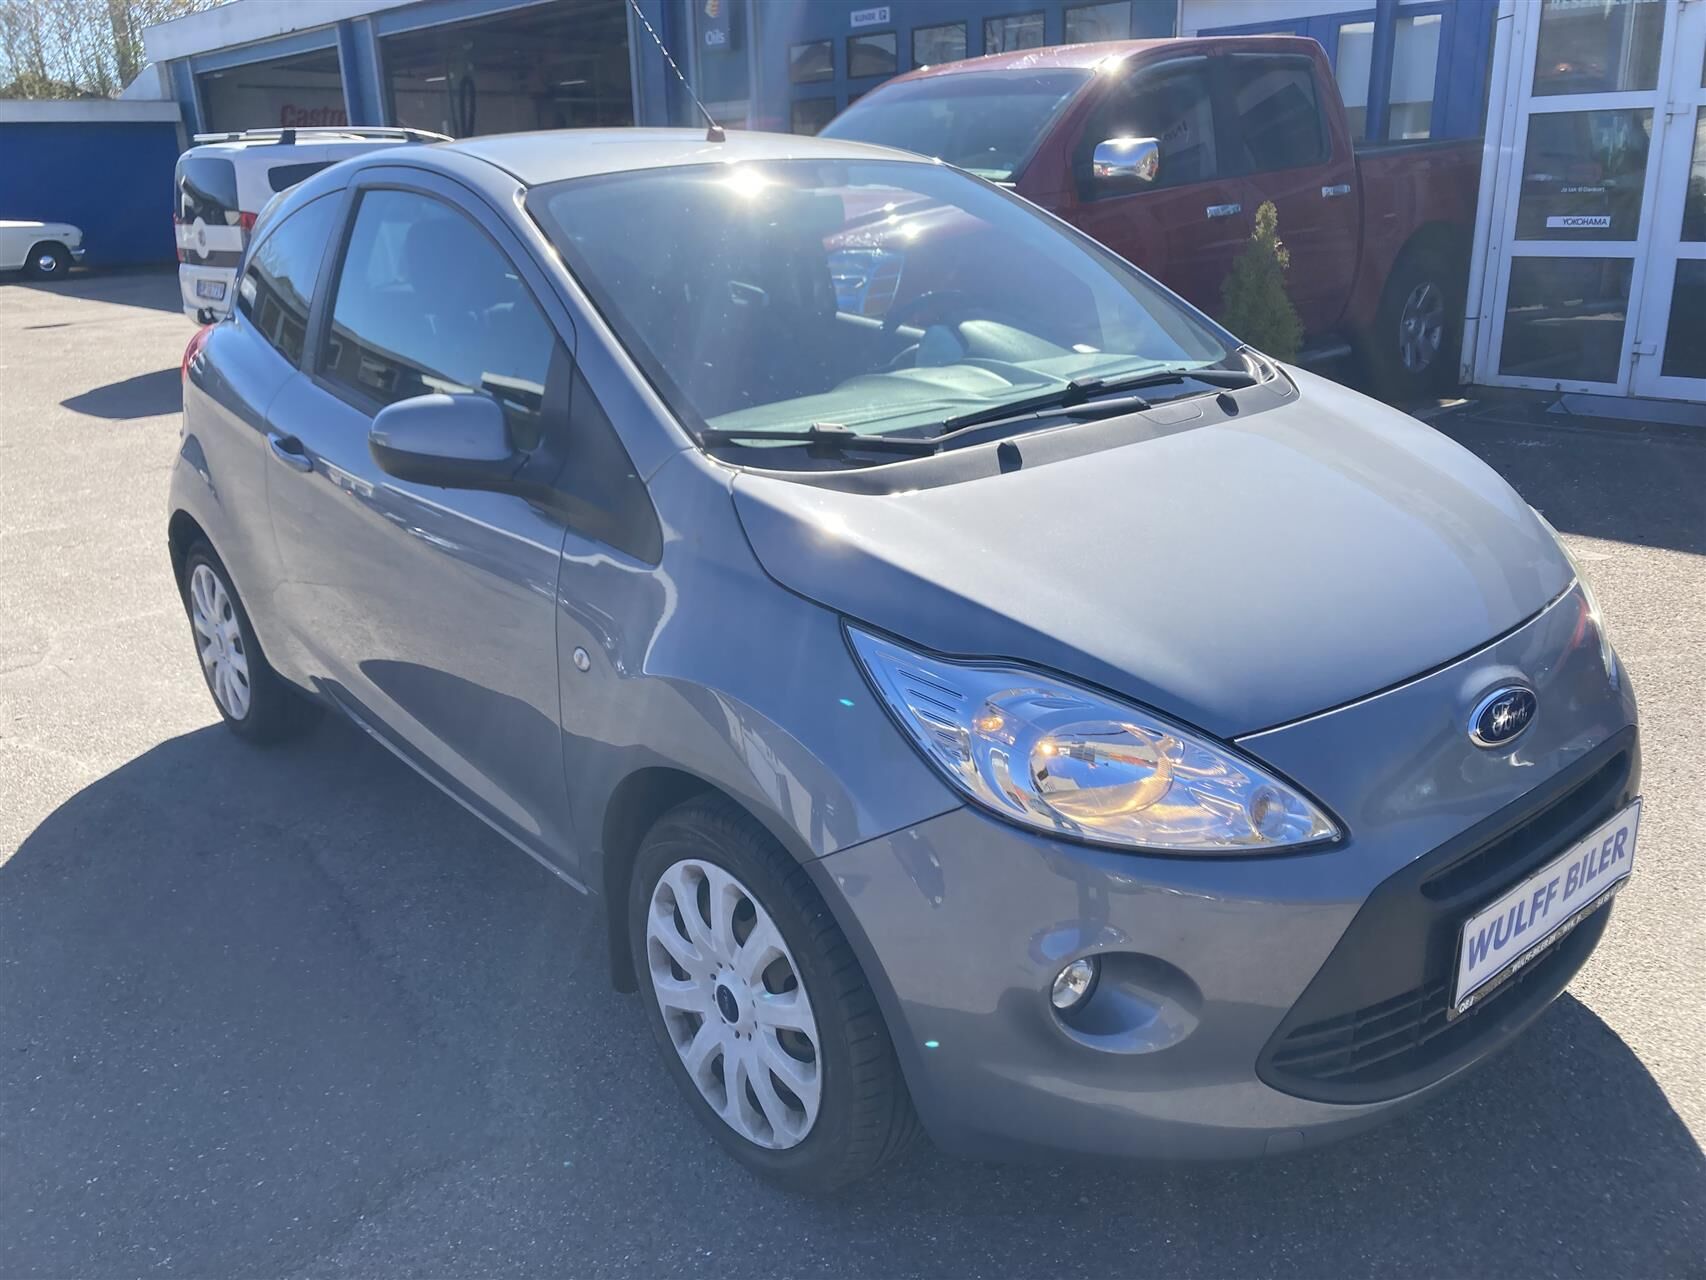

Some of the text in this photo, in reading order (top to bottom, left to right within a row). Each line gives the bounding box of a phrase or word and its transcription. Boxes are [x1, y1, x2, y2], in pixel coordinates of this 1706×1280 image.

[1563, 218, 1608, 226] YOKOHAMA
[1492, 697, 1528, 737] Ford
[1468, 826, 1629, 972] WULFF BILER
